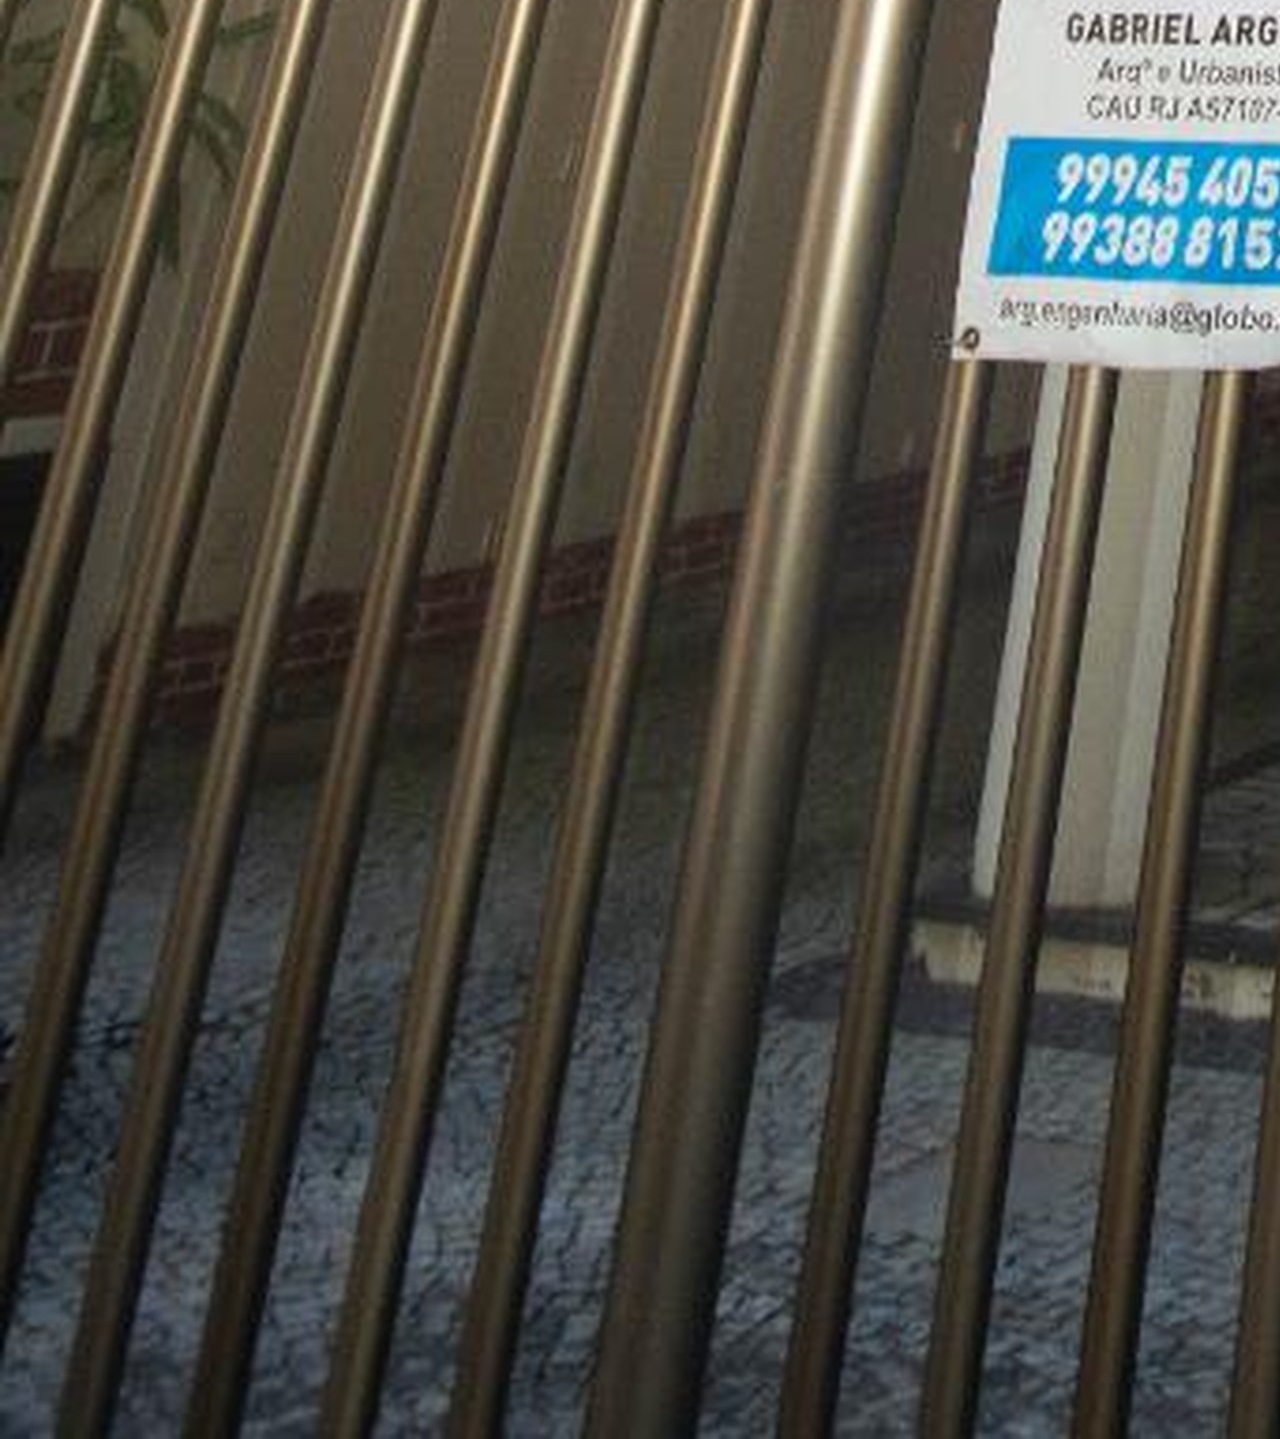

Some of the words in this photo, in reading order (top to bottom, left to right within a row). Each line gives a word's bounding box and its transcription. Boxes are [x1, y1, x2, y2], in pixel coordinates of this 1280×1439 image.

[1065, 13, 1201, 45] GABRIEL
[1086, 94, 1142, 121] CAU
[1149, 95, 1180, 121] RJ
[1057, 153, 1193, 207] 99945
[1042, 211, 1179, 267] 99388
